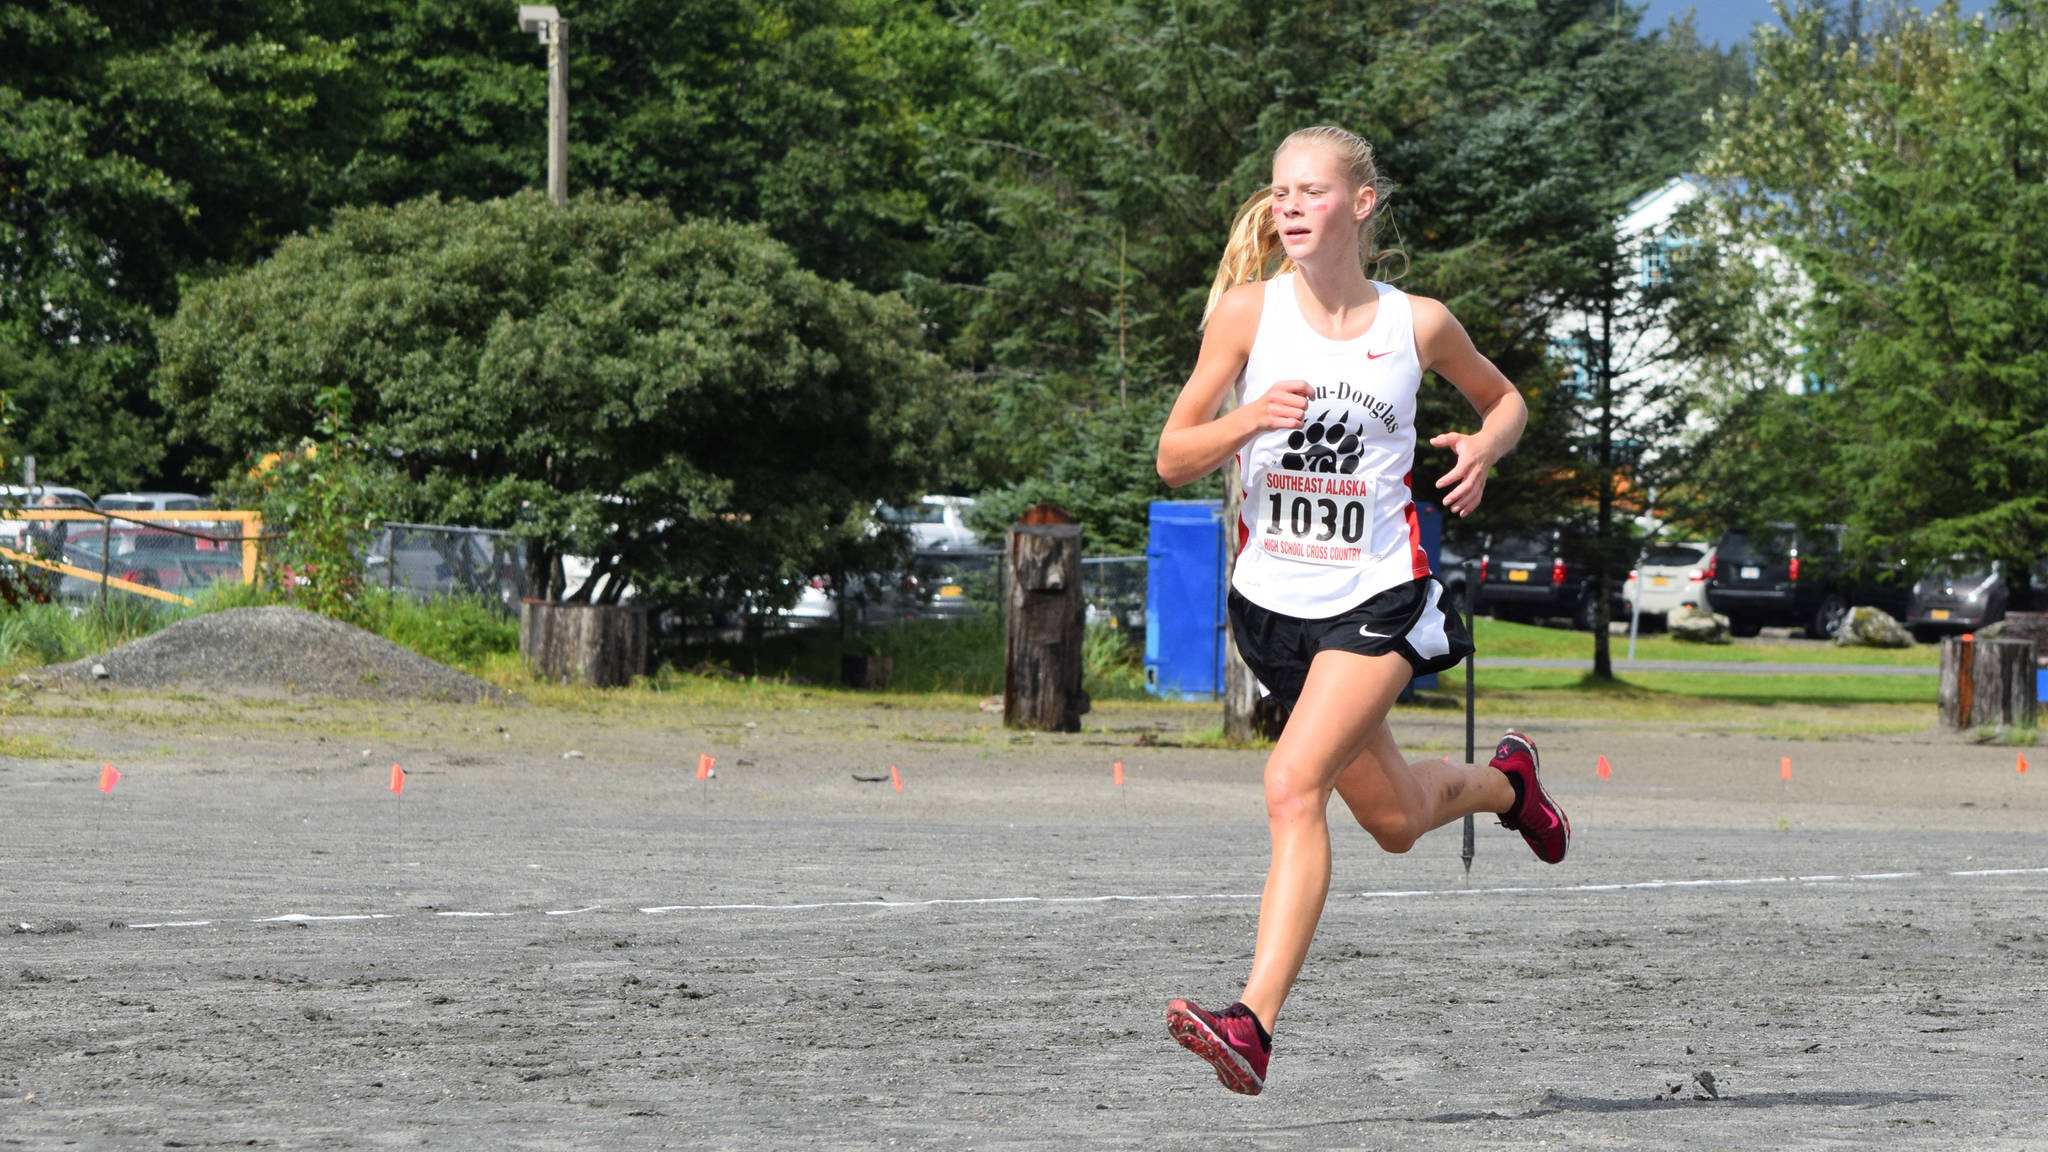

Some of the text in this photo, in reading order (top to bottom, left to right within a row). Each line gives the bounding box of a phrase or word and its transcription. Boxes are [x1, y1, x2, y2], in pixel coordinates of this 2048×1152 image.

[1307, 381, 1398, 434] u-Douglas
[1266, 472, 1366, 496] SOUTHEAST ALASKA
[1266, 493, 1364, 543] 1030
[1264, 538, 1361, 560] HIGH SCHOOL CROSS COUNTRY
